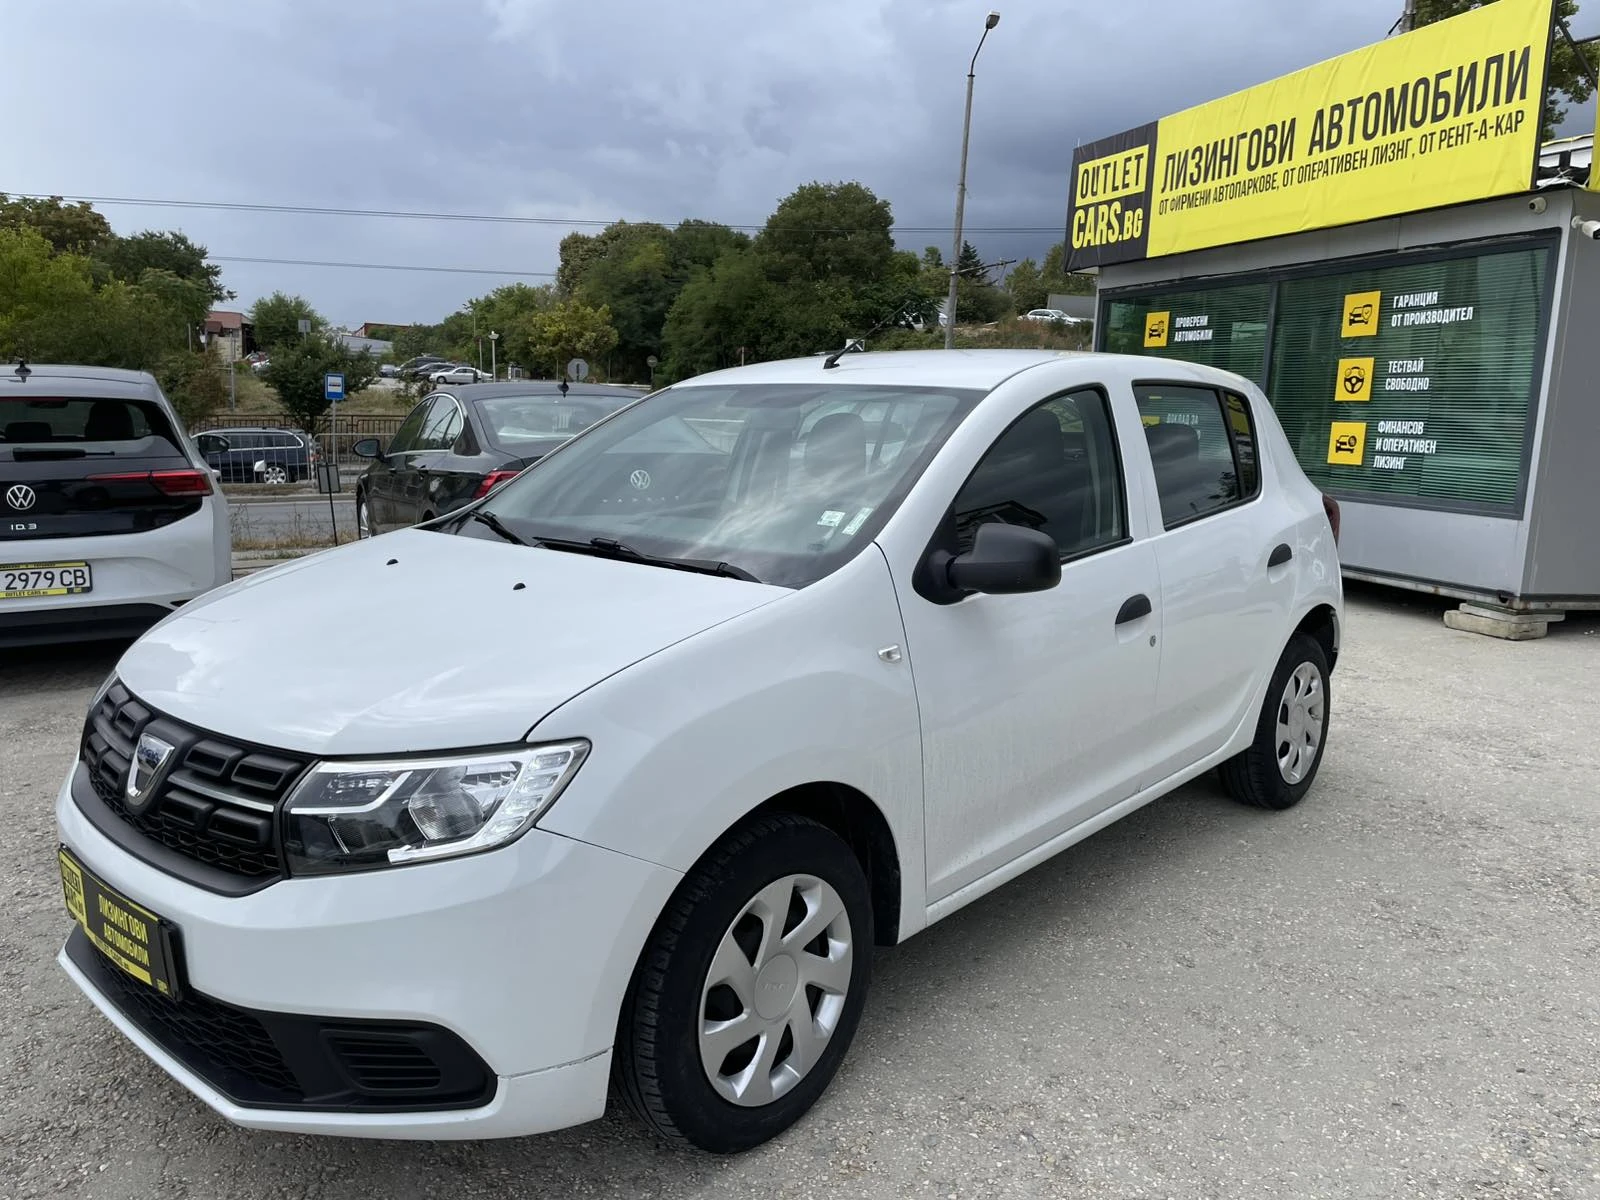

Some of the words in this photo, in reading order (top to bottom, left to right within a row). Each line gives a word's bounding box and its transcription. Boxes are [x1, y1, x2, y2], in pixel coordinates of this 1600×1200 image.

[1160, 117, 1296, 194] ЛИЗИНГОВИ
[1307, 45, 1531, 157] АВТОМОБИЛИ
[1159, 198, 1169, 215] ОТ
[1212, 171, 1279, 204] АВТОПАРКОВЕ,
[1282, 167, 1296, 188] ОТ
[1297, 149, 1368, 184] ОПЕРАТИВЕН
[1419, 131, 1436, 155] ОТ
[1438, 109, 1525, 151] РЕНТ-А-КАР
[1080, 153, 1144, 200] OUTLET
[1393, 291, 1438, 308] ГАРАНЦИЯ
[1391, 313, 1402, 327] ОТ
[1403, 306, 1474, 326] ПРОИЗВОДИТЕЛ
[1174, 329, 1213, 342] АВТОМОБИЛИ
[1388, 357, 1424, 373] ТЕСТВАЙ
[1385, 377, 1430, 391] СВОБОДНО
[1378, 420, 1424, 435] ФИНАНСОВ
[1375, 437, 1382, 451] И
[1382, 438, 1437, 454] ОПЕРАТИВЕН
[1373, 455, 1407, 470] ЛИЗИНГ
[4, 571, 55, 590] 2979
[98, 893, 149, 945] ЛИЗИНГОВИ
